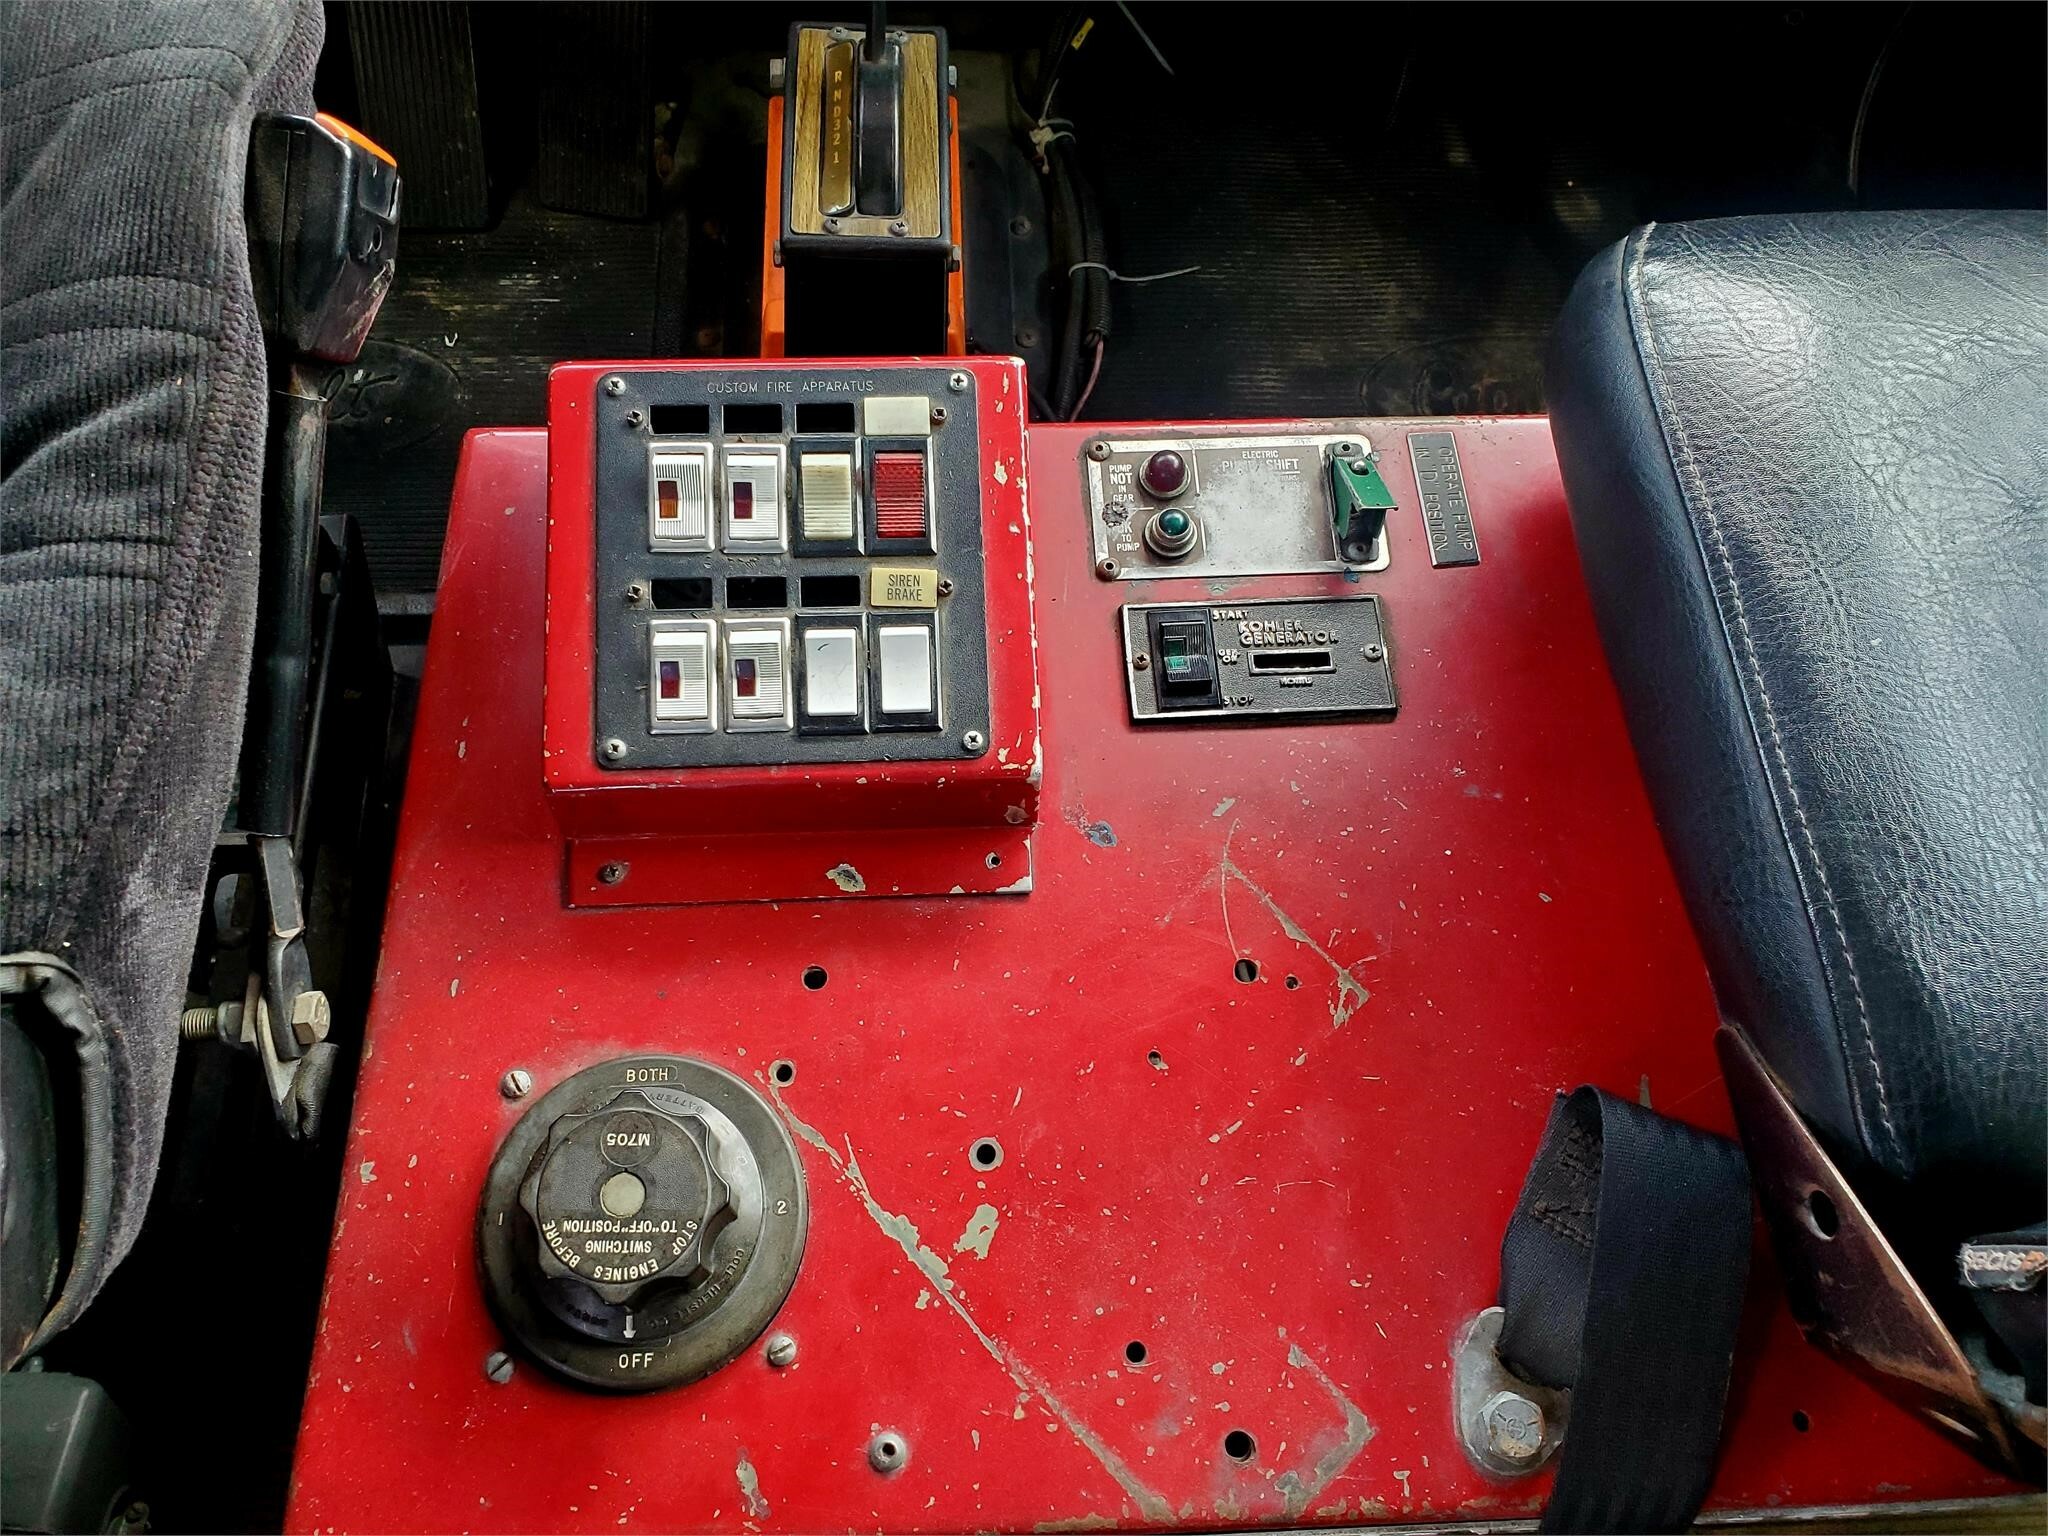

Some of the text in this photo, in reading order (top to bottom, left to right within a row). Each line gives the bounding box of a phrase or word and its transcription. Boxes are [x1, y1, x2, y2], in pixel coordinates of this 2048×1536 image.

[834, 70, 843, 83] R
[832, 133, 841, 146] 2
[833, 151, 840, 164] 1
[707, 380, 874, 394] CUSTOM FIRE APPARATUS
[1242, 450, 1280, 459] ELECTRIC
[1109, 464, 1132, 473] PUMP
[1266, 458, 1299, 471] SHIFT
[1110, 472, 1133, 485] NOT
[1118, 485, 1127, 494] IN
[1415, 447, 1431, 460] IN
[1423, 492, 1449, 552] POSITION
[1439, 446, 1474, 552] OPERATE PUMP
[1121, 534, 1132, 543] TO
[1116, 543, 1140, 552] PUMP
[888, 574, 921, 588] SIREN
[887, 588, 924, 602] BRAKE
[1212, 609, 1250, 621] START
[1238, 620, 1304, 635] KOHLER
[1240, 630, 1340, 648] GENERATOR
[626, 1067, 669, 1083] BOTH
[606, 1132, 651, 1147] M705
[776, 1200, 788, 1215] 2
[542, 1220, 698, 1281] STOP ENGINES BEFORE
[585, 1239, 653, 1254] SWITCHING
[618, 1352, 655, 1369] OFF
